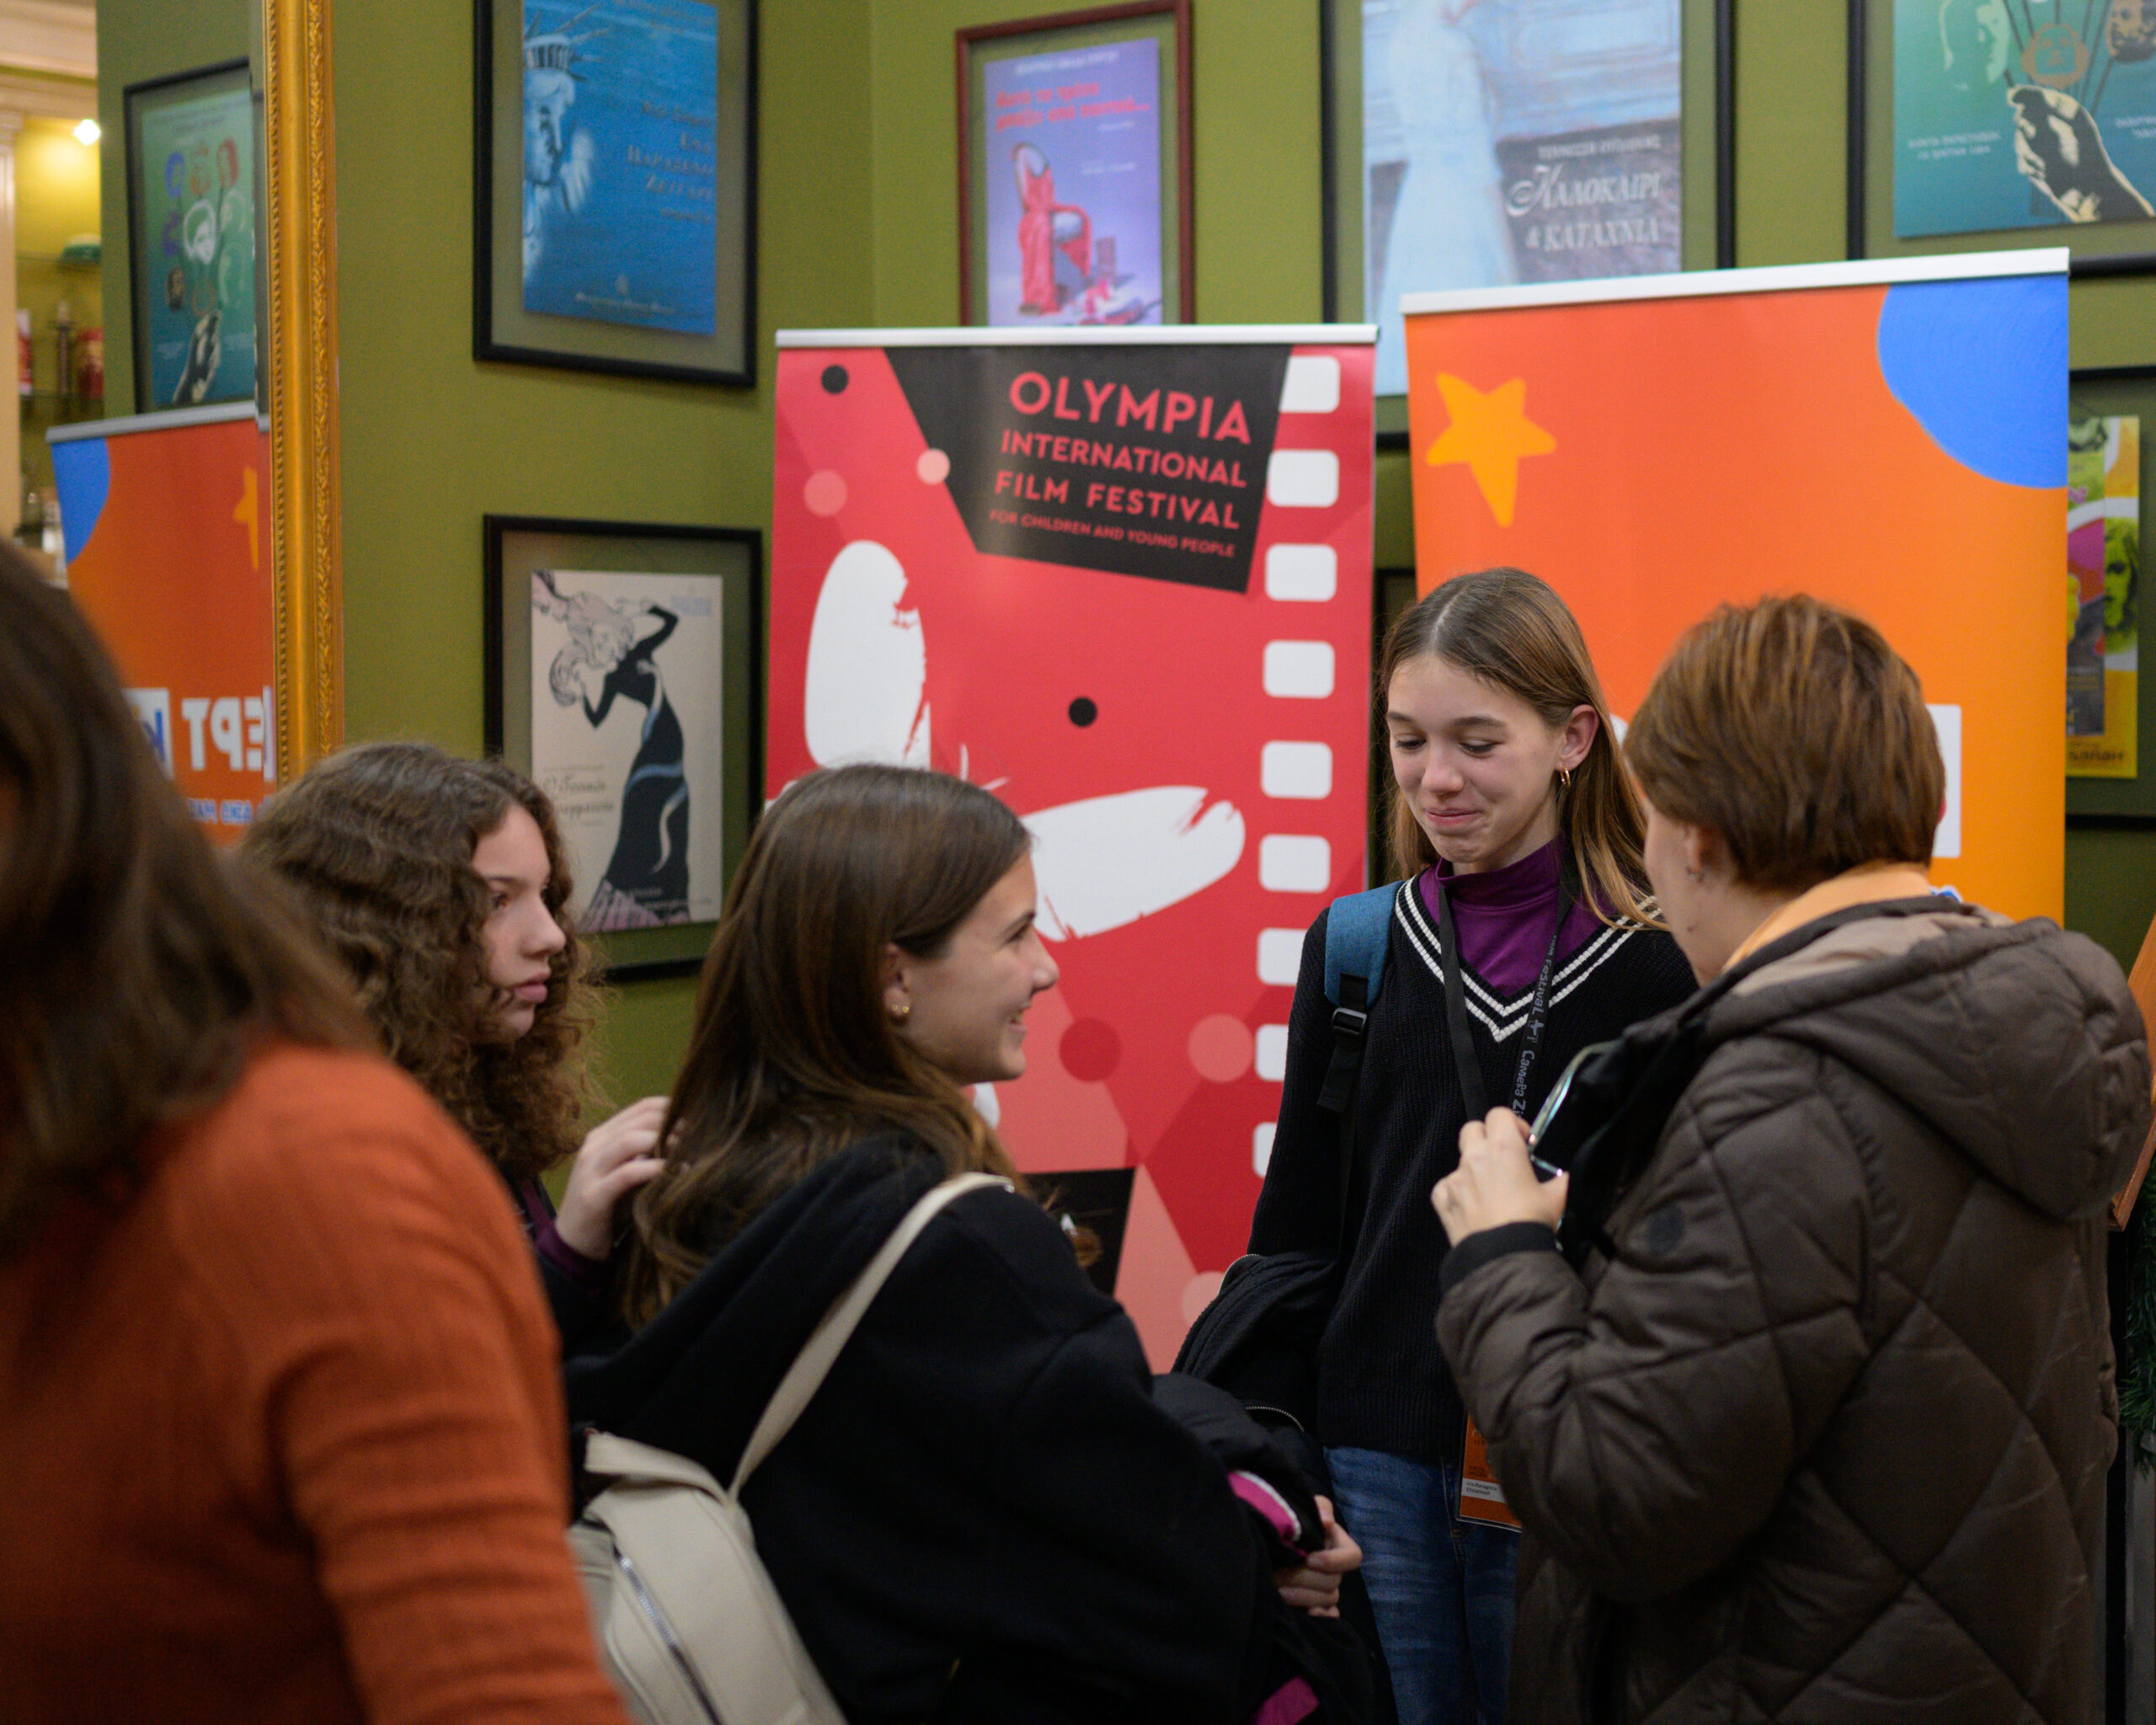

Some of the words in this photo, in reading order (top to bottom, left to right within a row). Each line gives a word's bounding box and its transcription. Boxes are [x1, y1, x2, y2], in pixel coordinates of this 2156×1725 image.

[1011, 371, 1251, 445] OLYMPIA
[1001, 429, 1247, 489] INTERNATIONAL
[995, 469, 1069, 505] FILM
[1086, 483, 1240, 530] FESTIVAL
[988, 509, 1018, 524] FOR
[1021, 512, 1091, 536] CHILDREN
[1094, 525, 1124, 542] AND
[1127, 530, 1178, 550] YOUNG
[1181, 537, 1235, 558] PEOPLE
